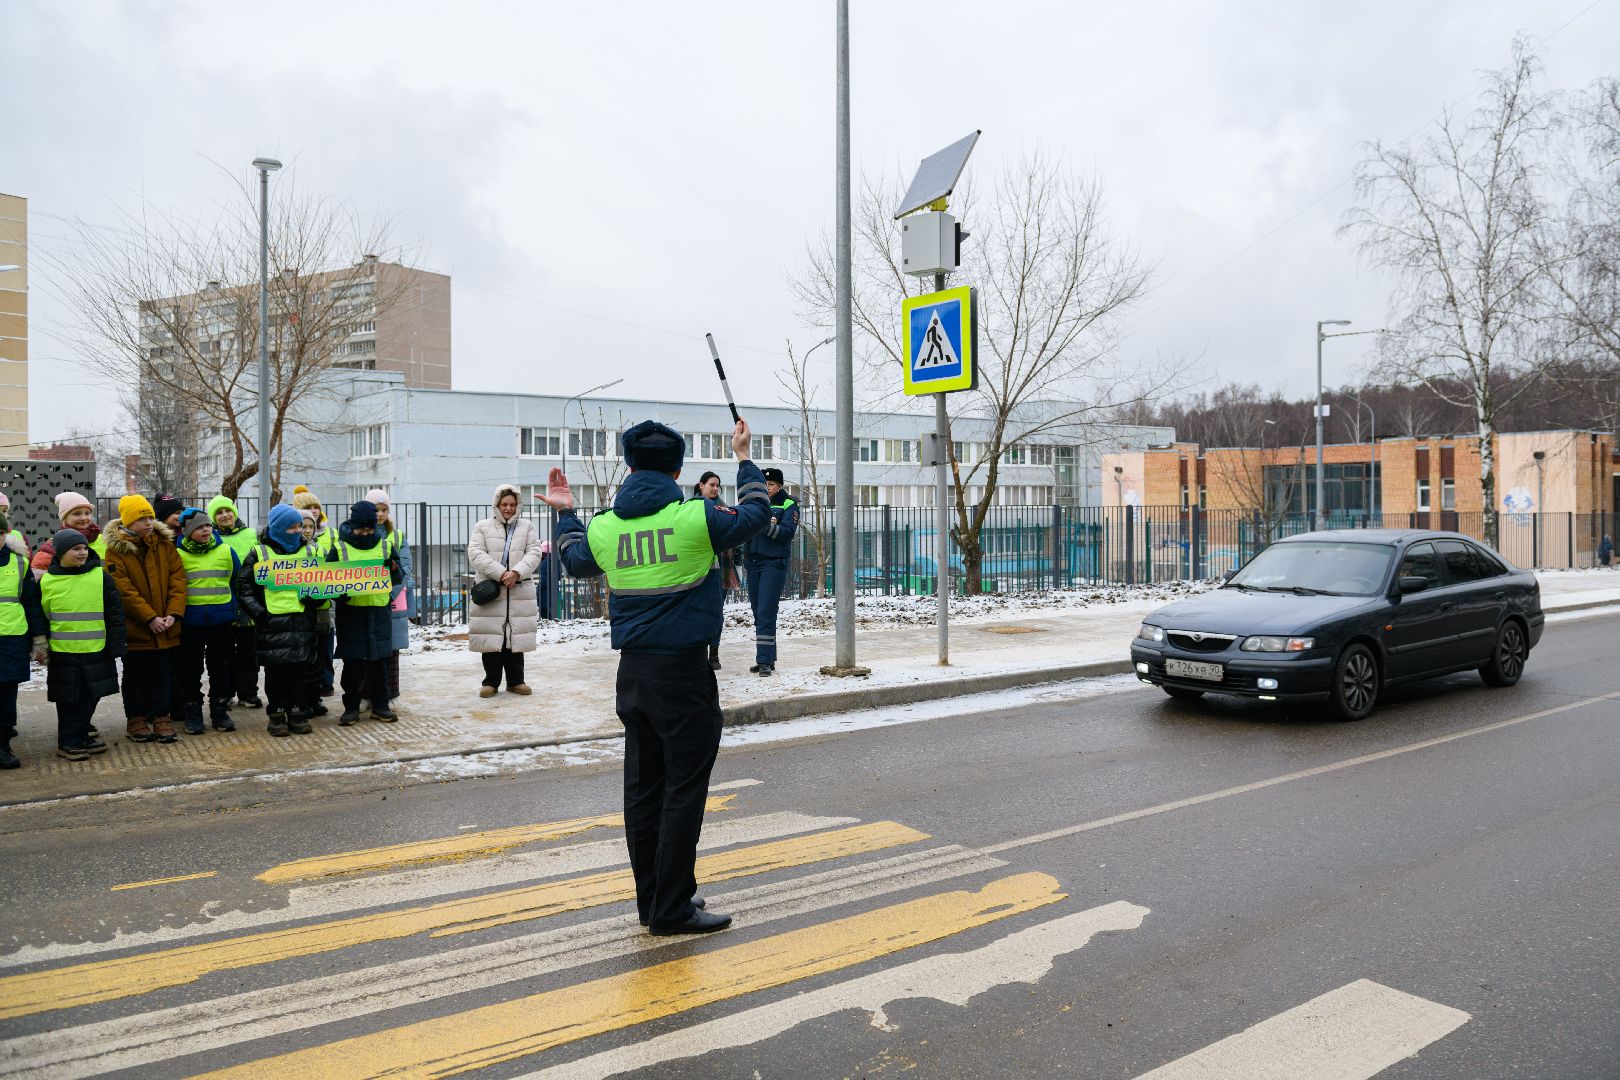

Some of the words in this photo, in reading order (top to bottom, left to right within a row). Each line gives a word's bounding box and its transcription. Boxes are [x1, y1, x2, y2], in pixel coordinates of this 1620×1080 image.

[616, 528, 678, 569] ДПС
[301, 558, 319, 568] ЗА
[275, 565, 389, 586] БЕЗОПАСНОСТЬ
[300, 586, 320, 596] НА
[323, 580, 390, 596] ДОРОГАХ
